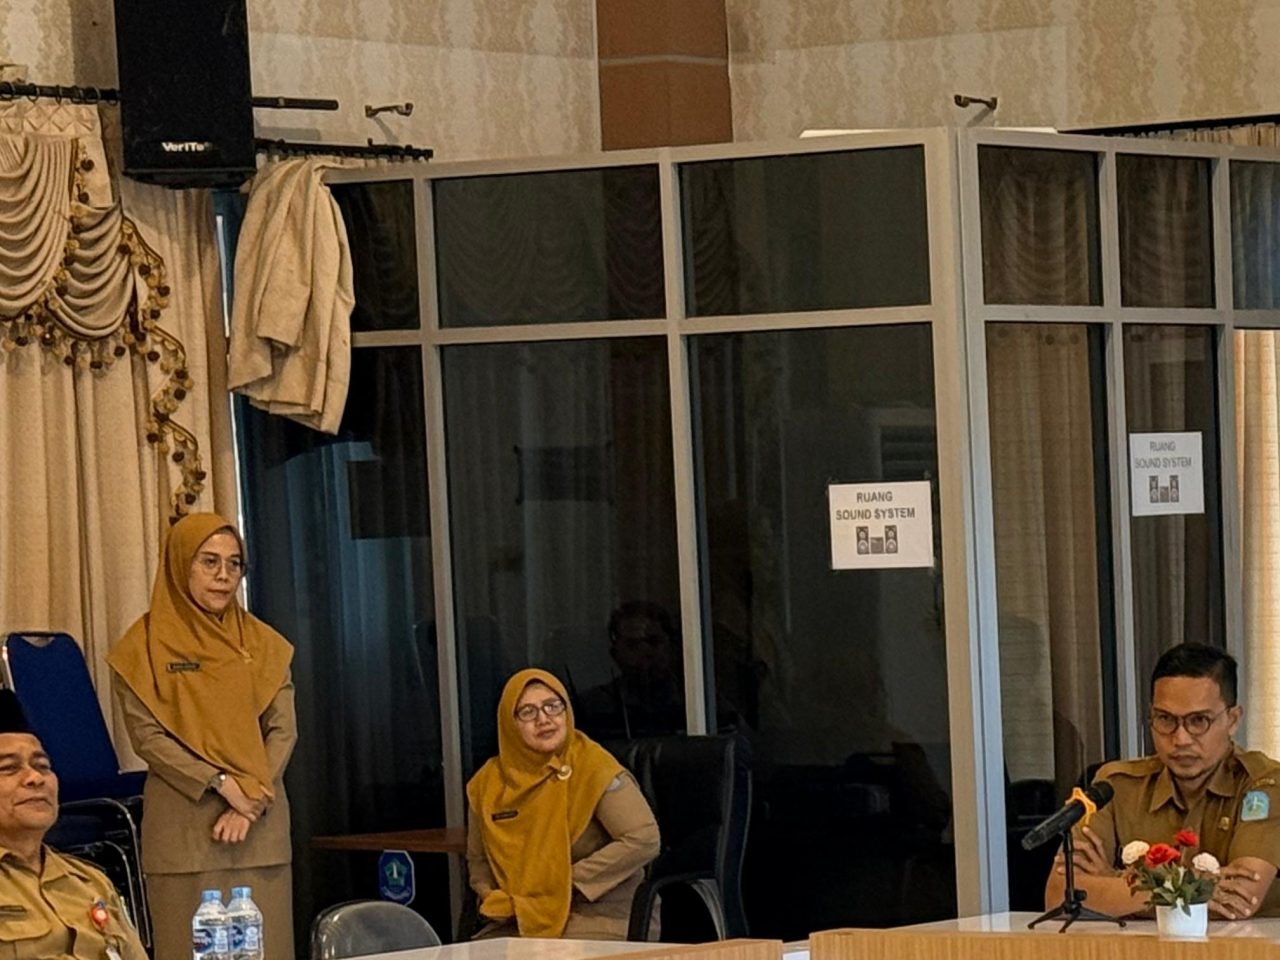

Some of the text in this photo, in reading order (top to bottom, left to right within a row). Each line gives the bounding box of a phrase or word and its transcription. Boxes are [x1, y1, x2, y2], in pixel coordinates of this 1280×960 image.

[1149, 440, 1176, 452] RUANG
[1162, 456, 1192, 468] SYSTEM
[856, 491, 893, 503] RUANG
[835, 507, 916, 521] SOUND SYSTEM
